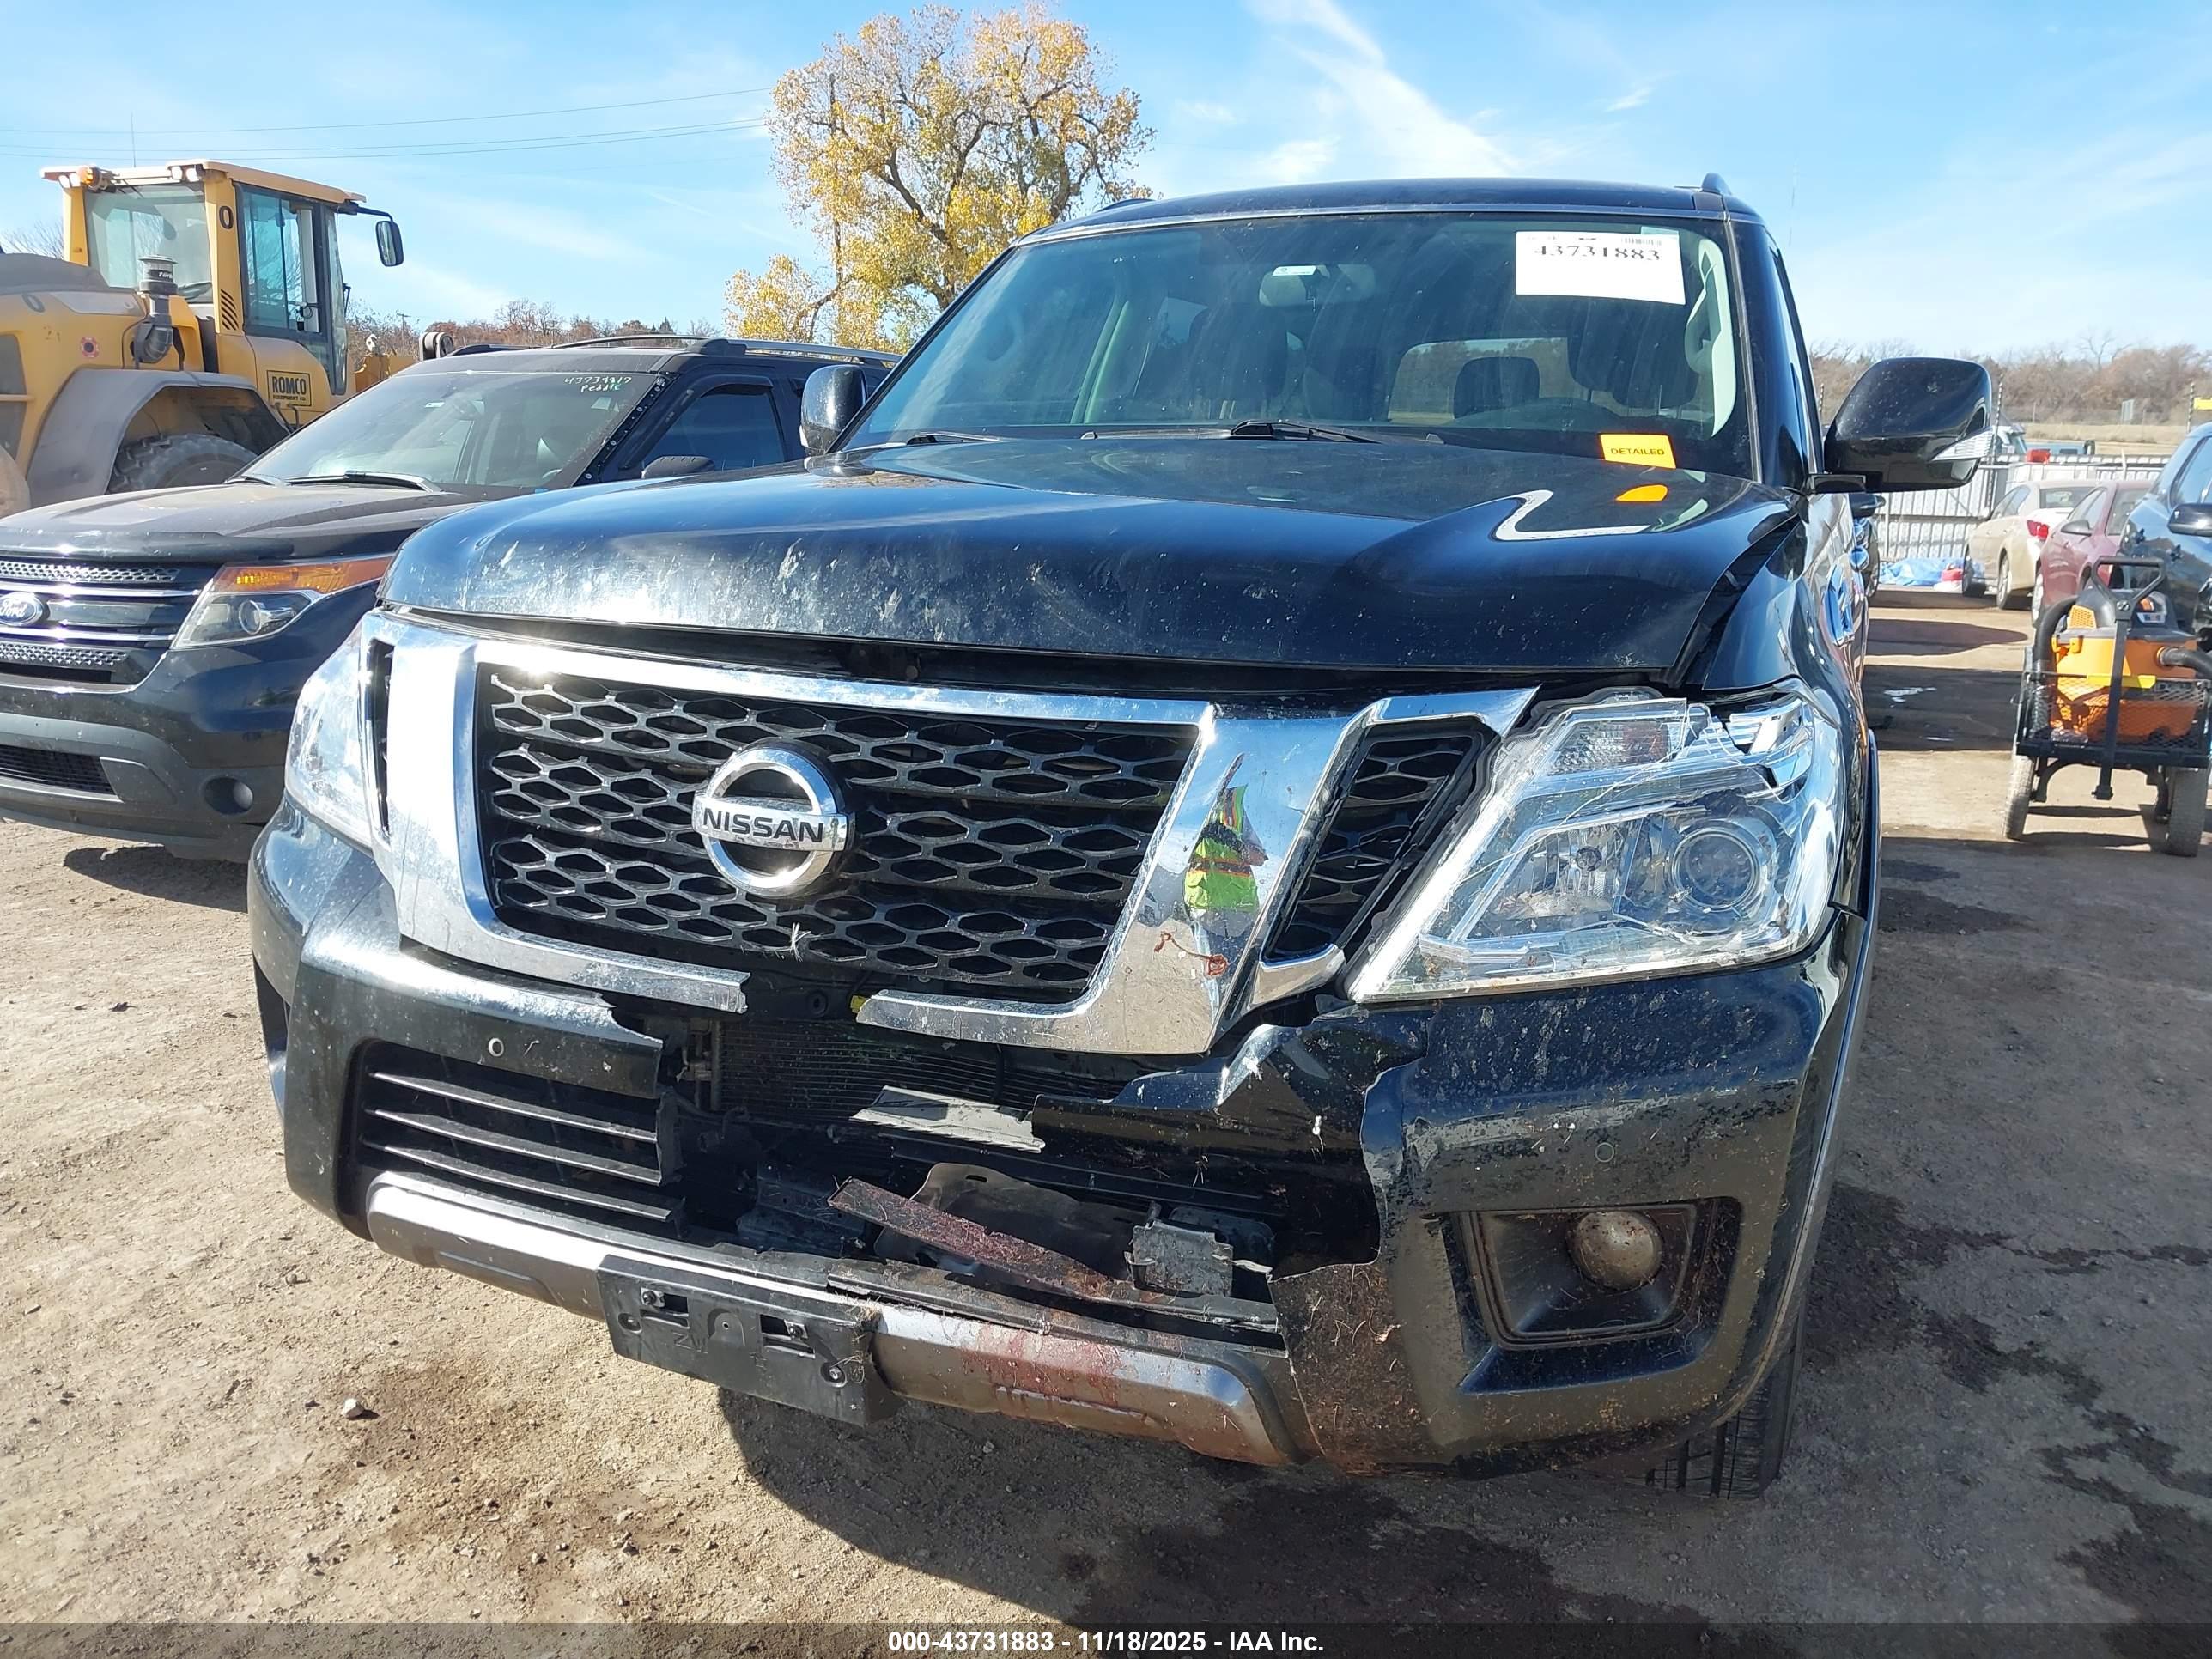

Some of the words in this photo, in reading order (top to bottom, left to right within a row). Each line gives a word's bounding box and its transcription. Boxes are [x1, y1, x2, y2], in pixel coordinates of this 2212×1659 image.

[1534, 245, 1661, 261] 43731883
[272, 376, 307, 395] ROMCO
[702, 807, 824, 843] NISSAN
